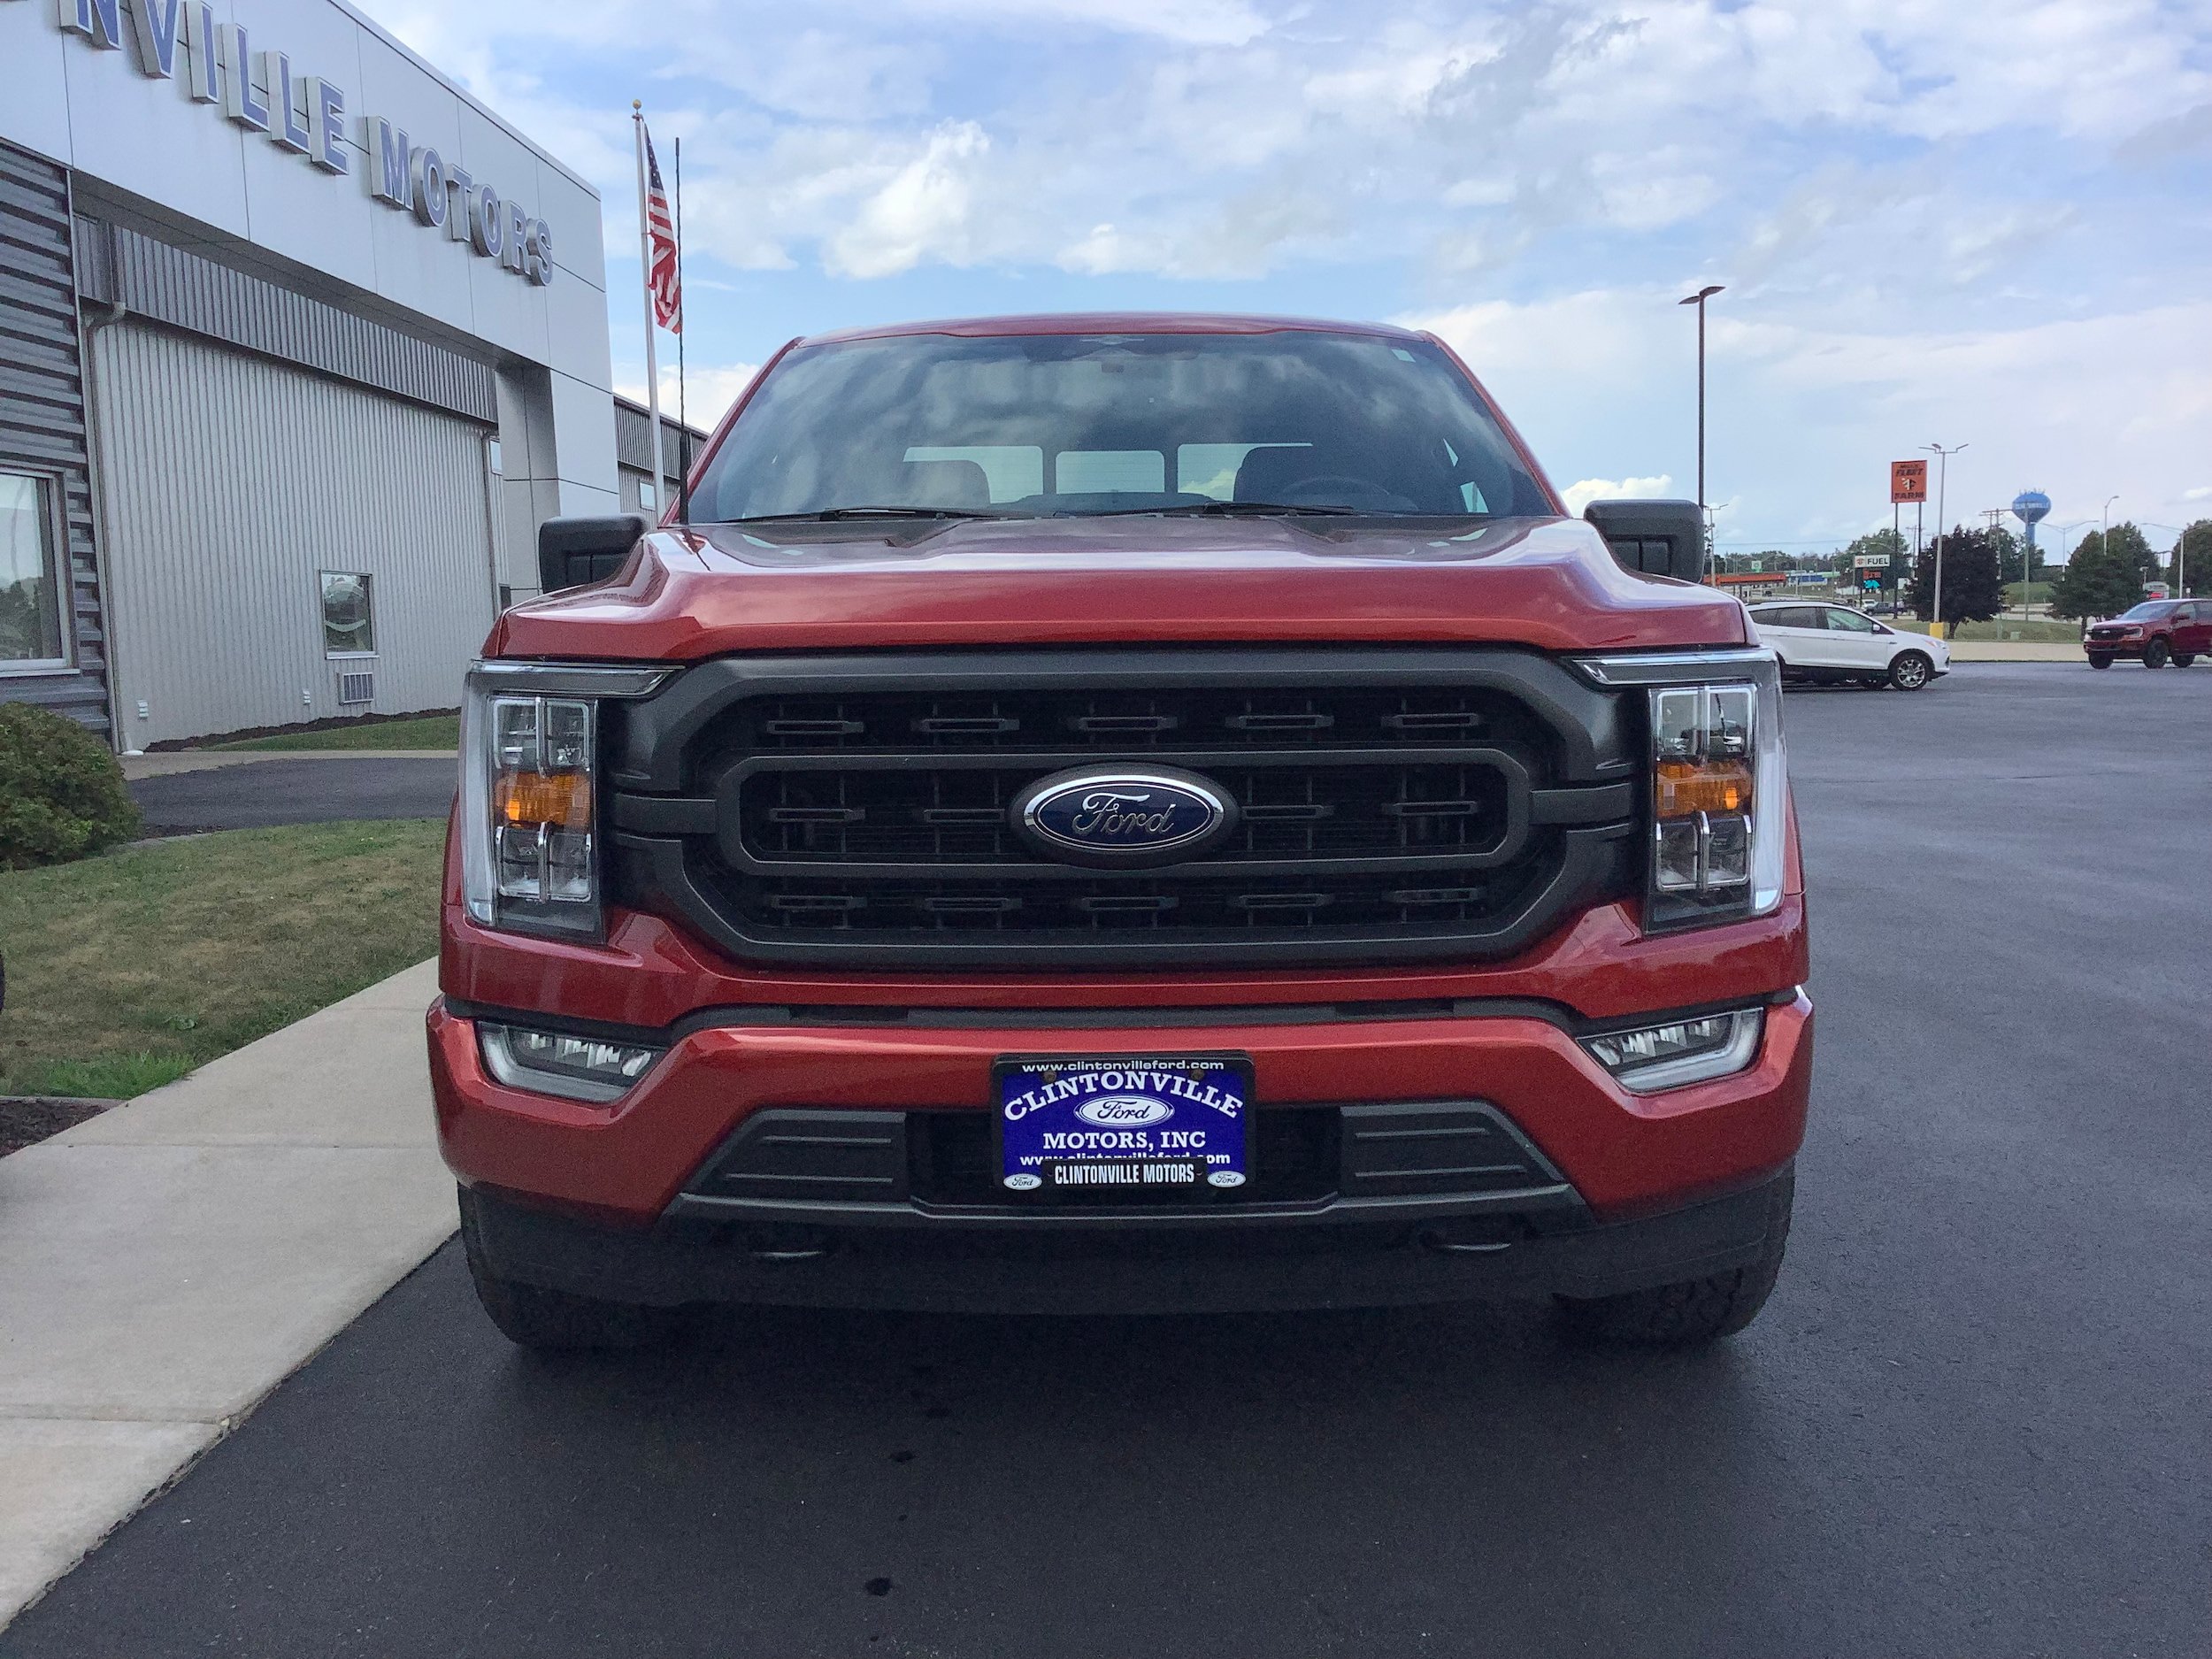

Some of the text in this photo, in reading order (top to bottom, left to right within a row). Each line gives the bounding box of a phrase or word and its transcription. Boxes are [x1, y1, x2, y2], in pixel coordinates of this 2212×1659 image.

[365, 116, 553, 287] MOTORS
[1071, 792, 1177, 835] Ford
[1022, 1060, 1225, 1072] www.clintonvilleford.com
[1004, 1071, 1244, 1121] CLINTONVILLE
[1097, 1101, 1151, 1119] Ford
[1043, 1131, 1206, 1151] MOTORS, INC
[1011, 1177, 1033, 1187] Ford
[1055, 1164, 1194, 1185] CLINTONVILLE MOTORS
[1216, 1174, 1238, 1184] Ford
